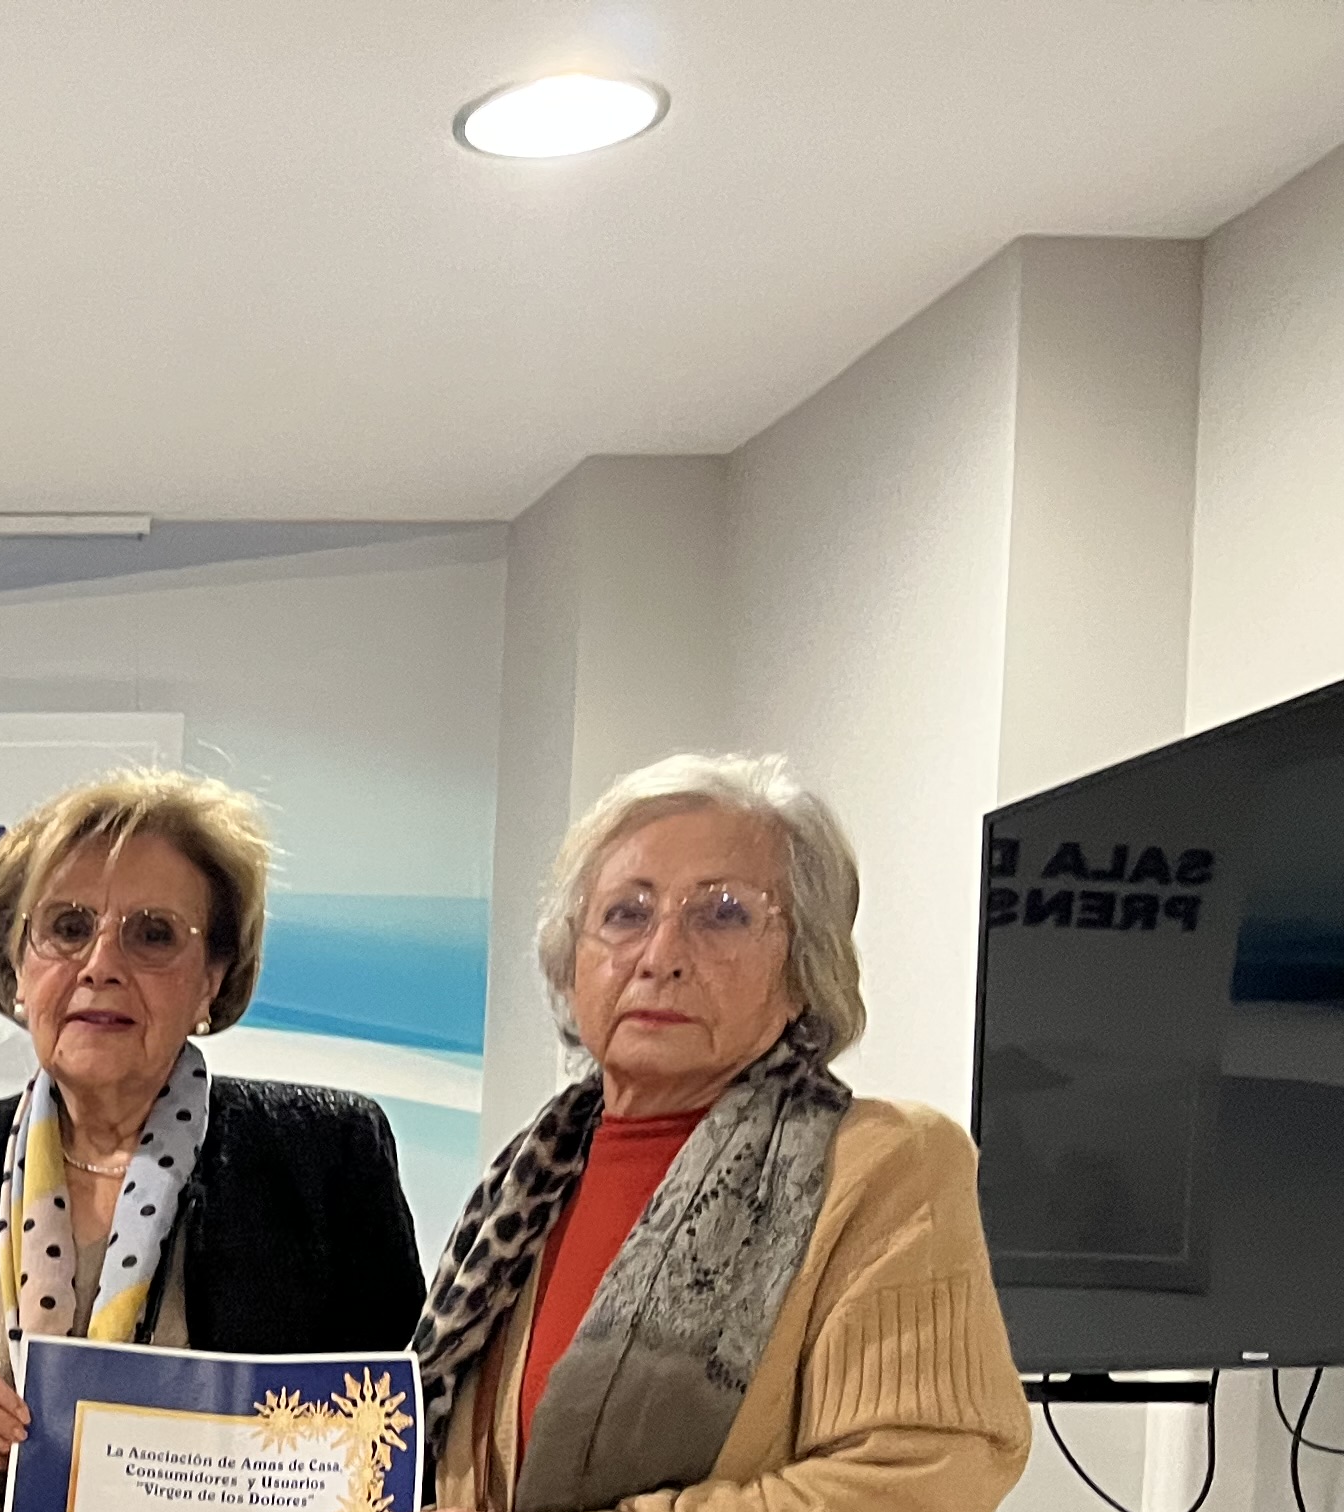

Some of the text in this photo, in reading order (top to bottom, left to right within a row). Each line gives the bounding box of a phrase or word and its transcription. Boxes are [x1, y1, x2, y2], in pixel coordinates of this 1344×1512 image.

[106, 1444, 343, 1474] La Asociación de Amas de Casa,
[125, 1463, 325, 1490] Consumidores y Usuarios
[136, 1480, 314, 1507] "Virgen de los Dolores"
